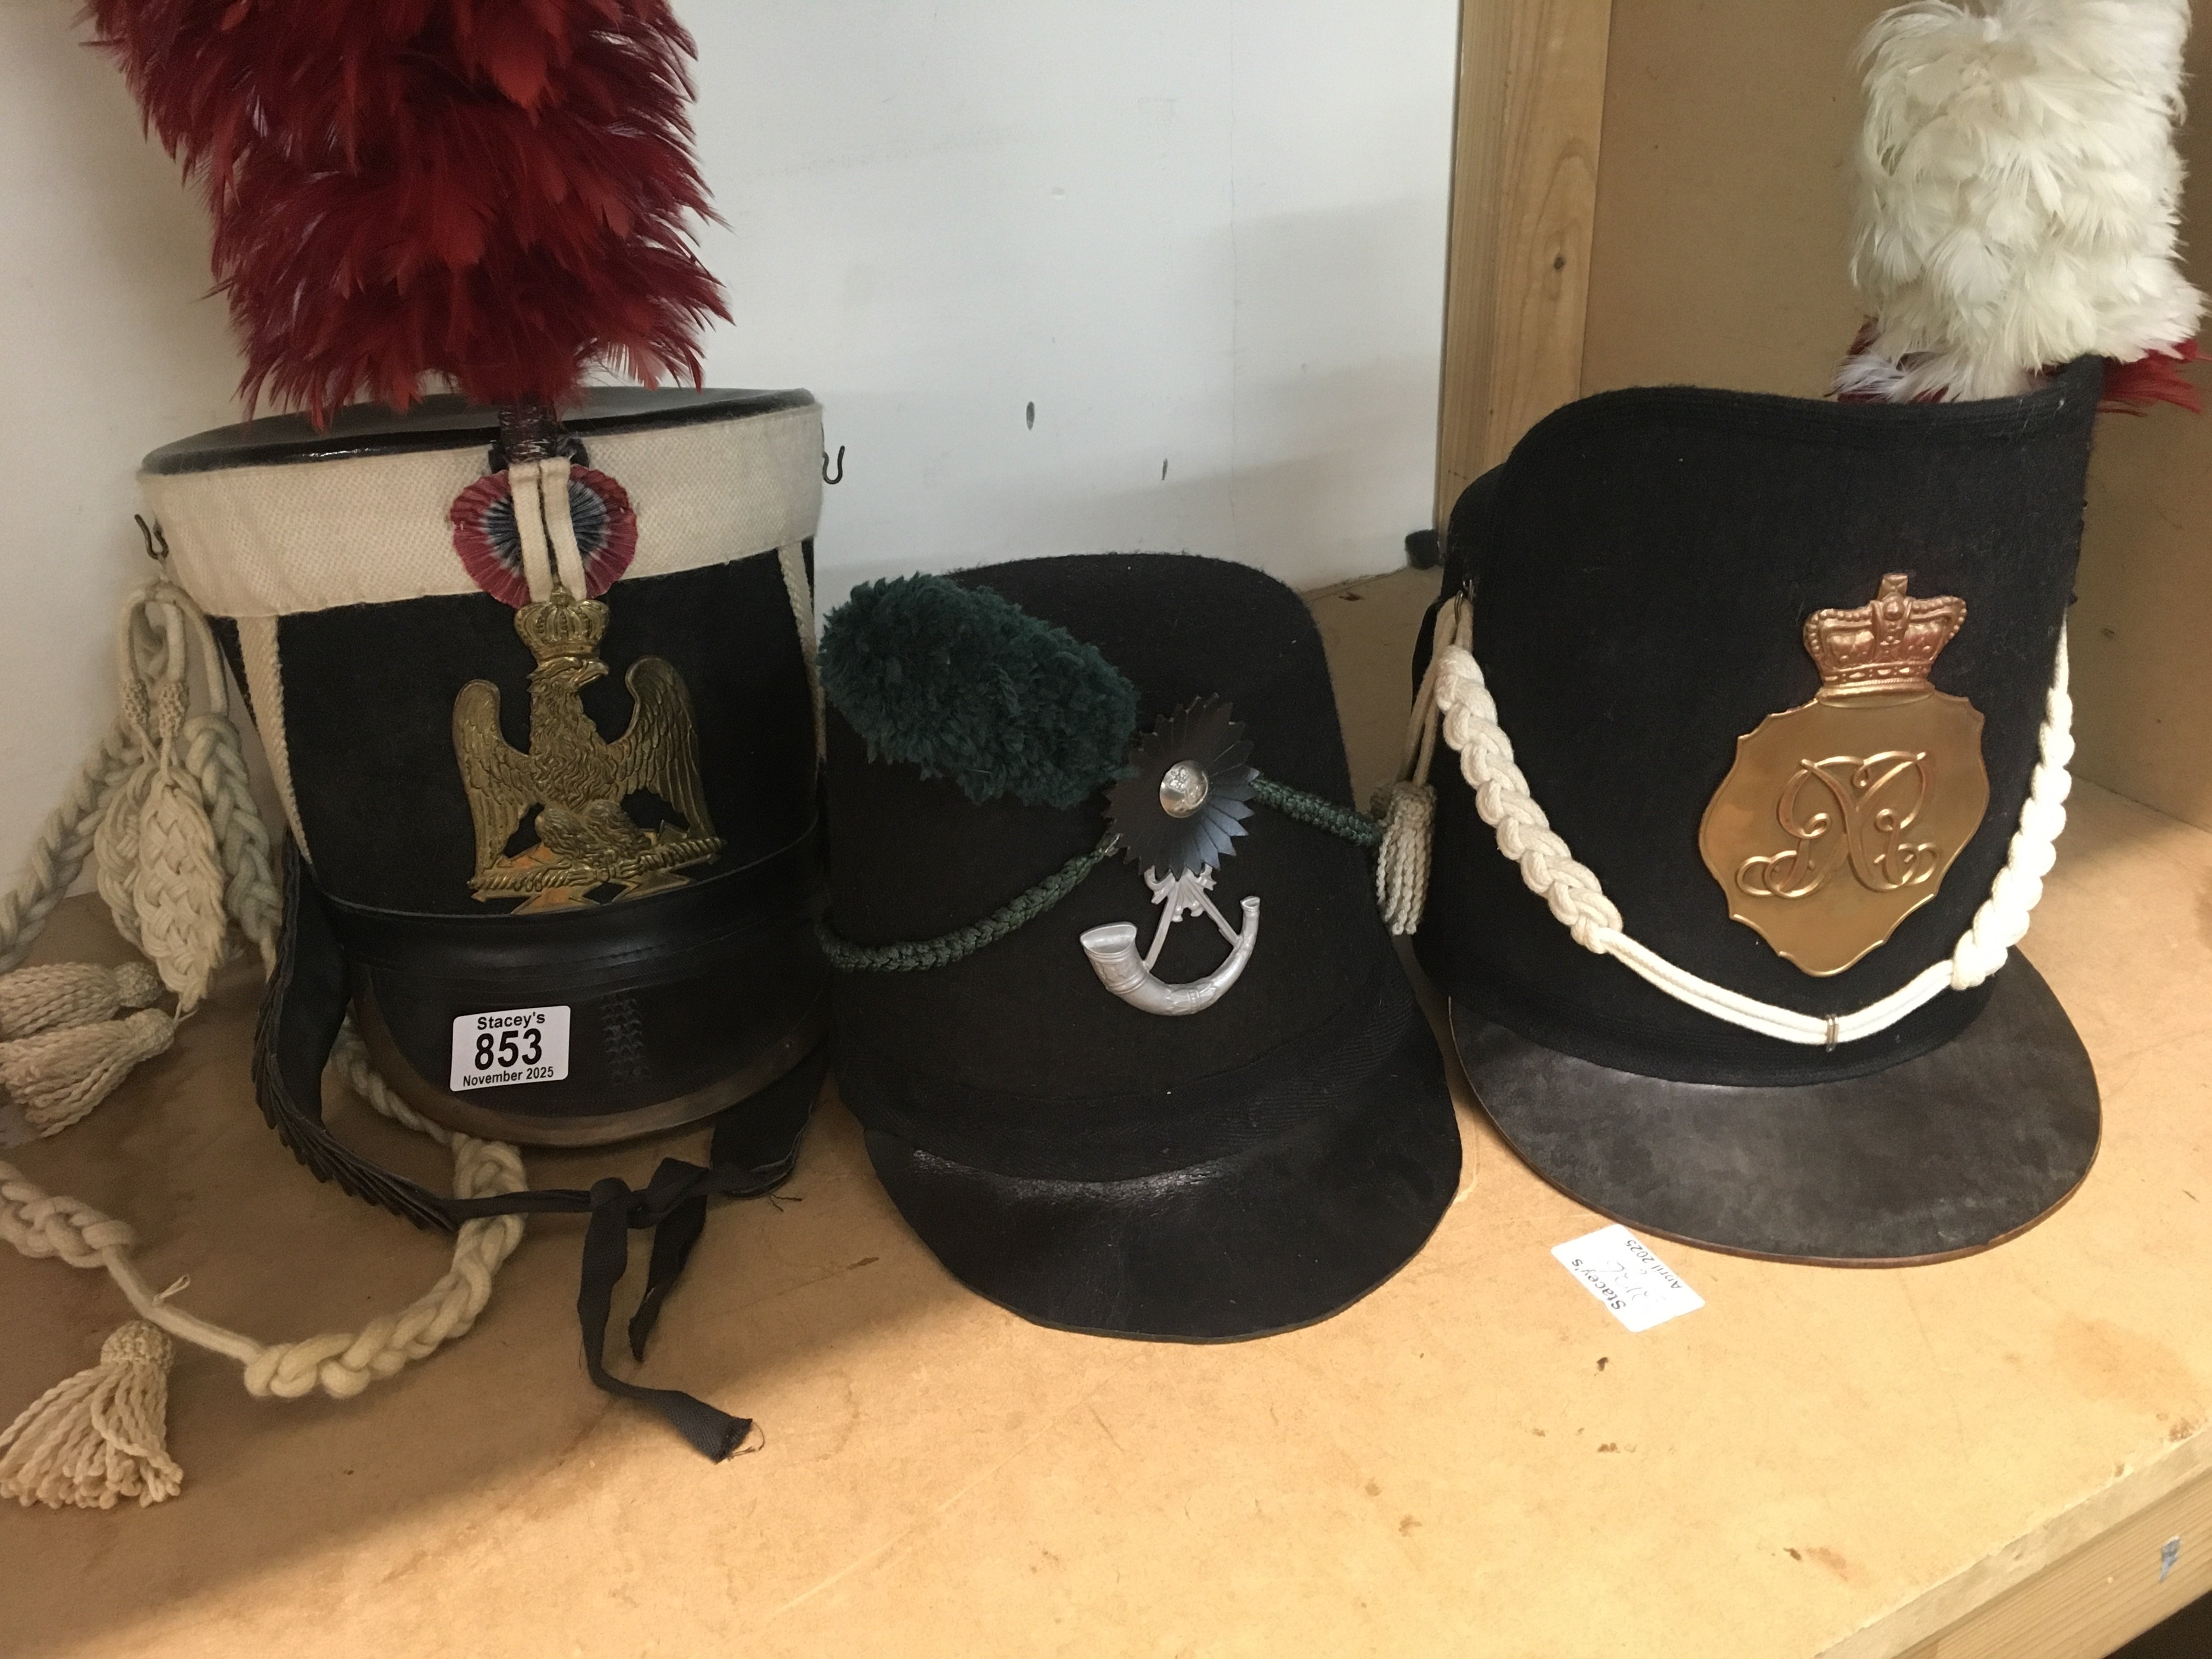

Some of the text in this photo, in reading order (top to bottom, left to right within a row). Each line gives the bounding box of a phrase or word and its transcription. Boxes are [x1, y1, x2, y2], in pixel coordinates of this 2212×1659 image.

[477, 1012, 545, 1030] Stacey's
[475, 1028, 542, 1071] 853
[462, 1066, 554, 1087] November 2025
[1624, 1239, 1655, 1263] 2025
[1571, 1259, 1627, 1310] Stacey's
